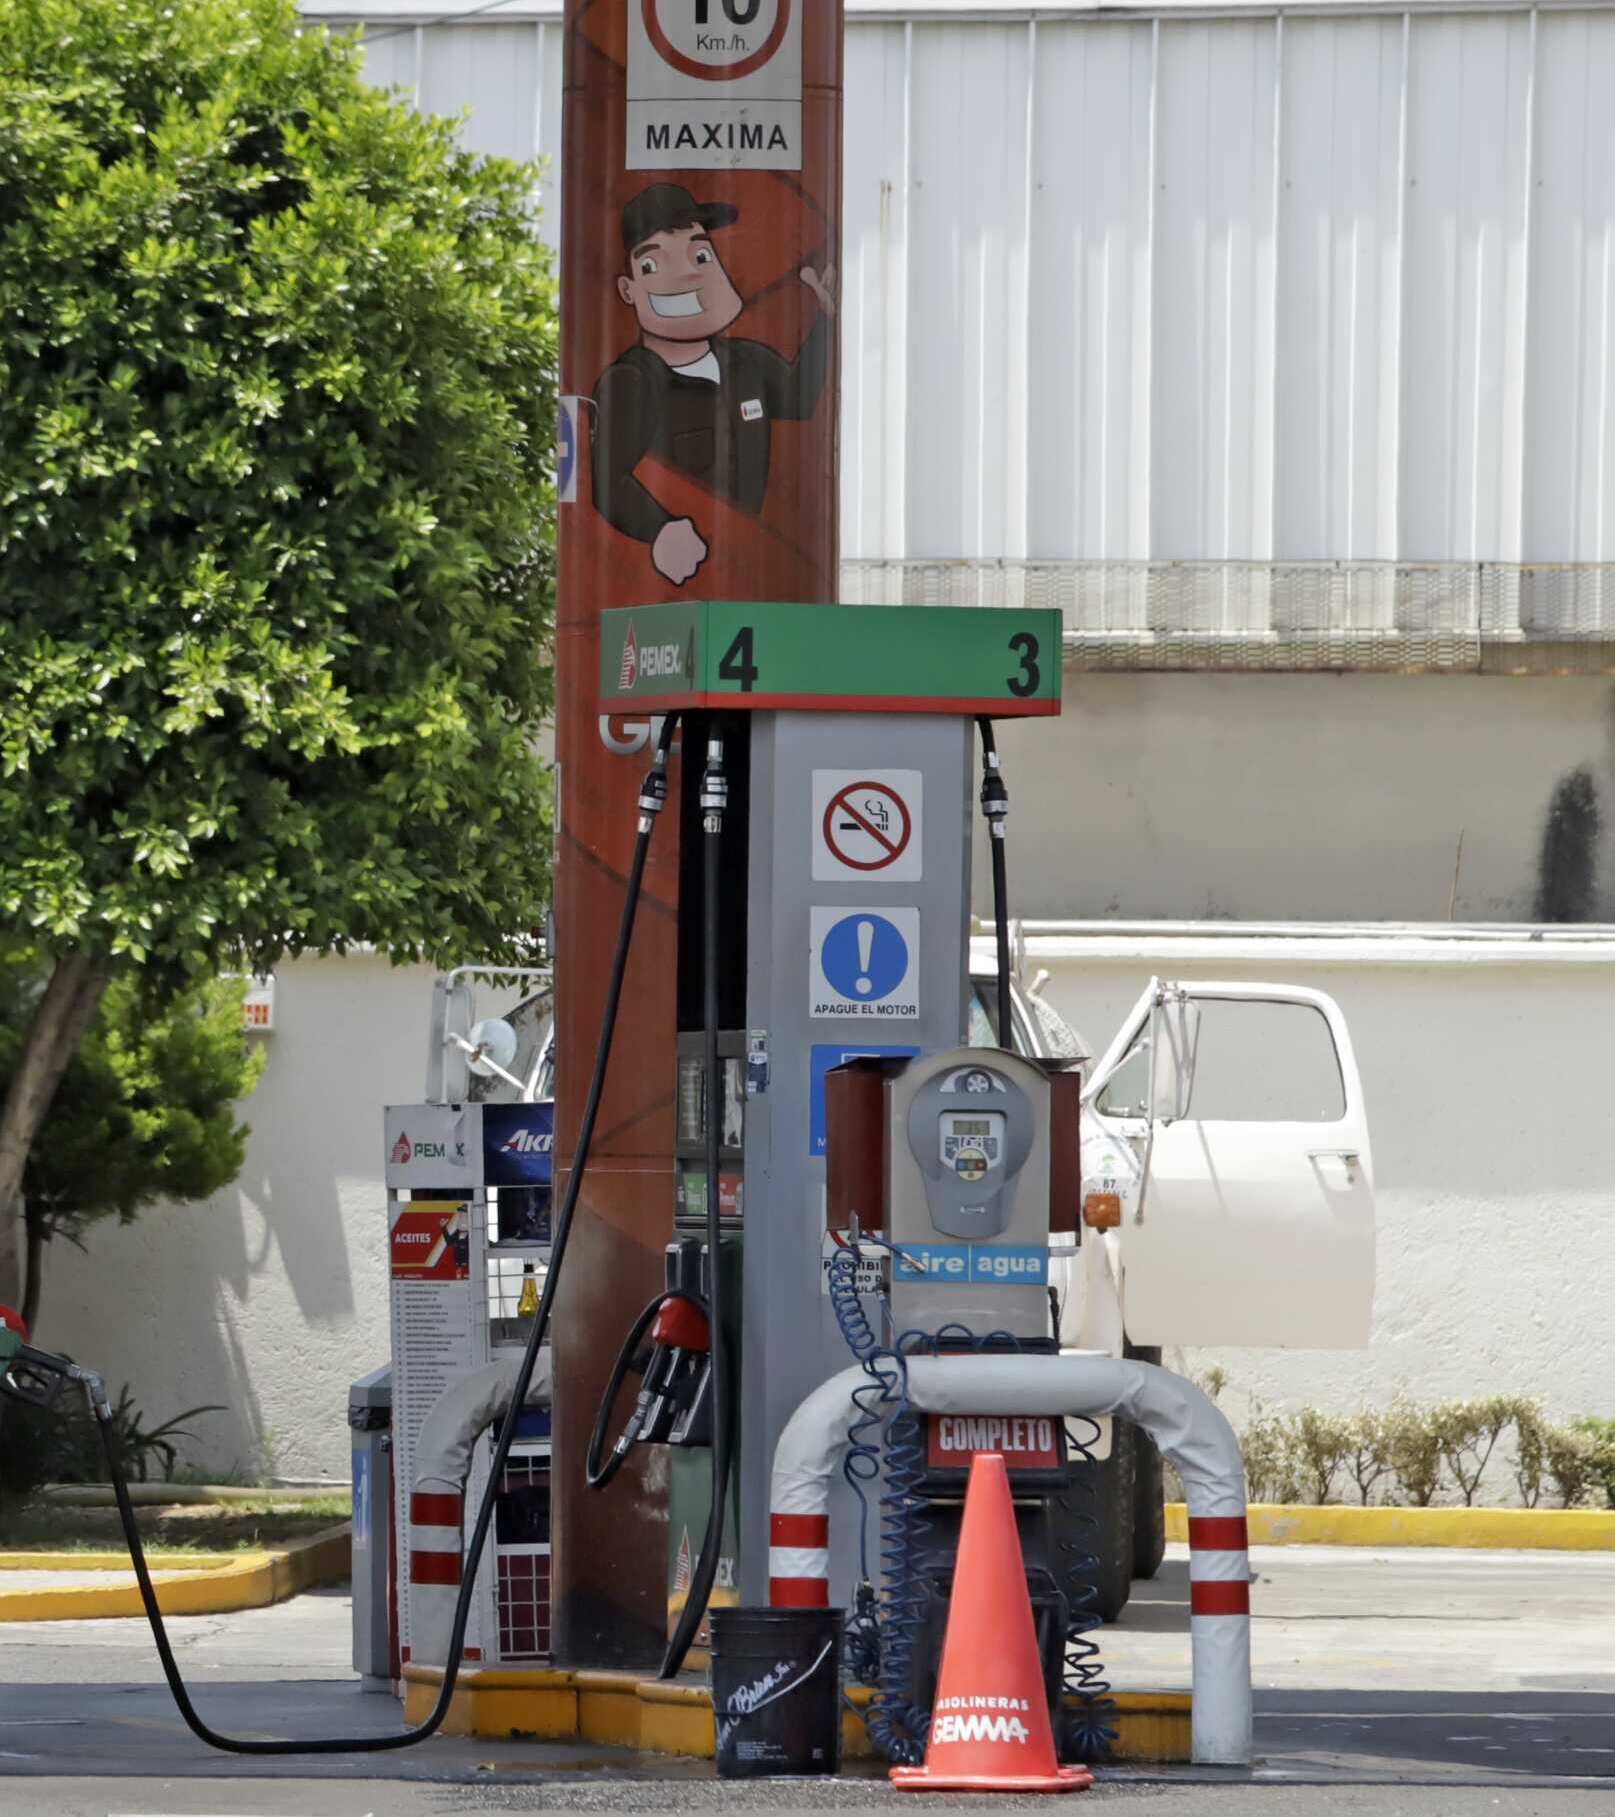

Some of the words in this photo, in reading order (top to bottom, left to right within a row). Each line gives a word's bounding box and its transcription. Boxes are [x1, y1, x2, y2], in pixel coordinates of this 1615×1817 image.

[646, 123, 788, 150] MAXIMA
[639, 645, 681, 676] PEMEX
[719, 626, 759, 692] 4
[1006, 632, 1041, 697] 3
[814, 1004, 859, 1014] APAGUE
[861, 1004, 874, 1014] EL
[877, 1004, 917, 1015] MOTOR
[414, 1142, 465, 1158] PEMX
[395, 1233, 432, 1244] ACEITES
[977, 1257, 1042, 1277] agua
[939, 1417, 1052, 1453] COMPLETO
